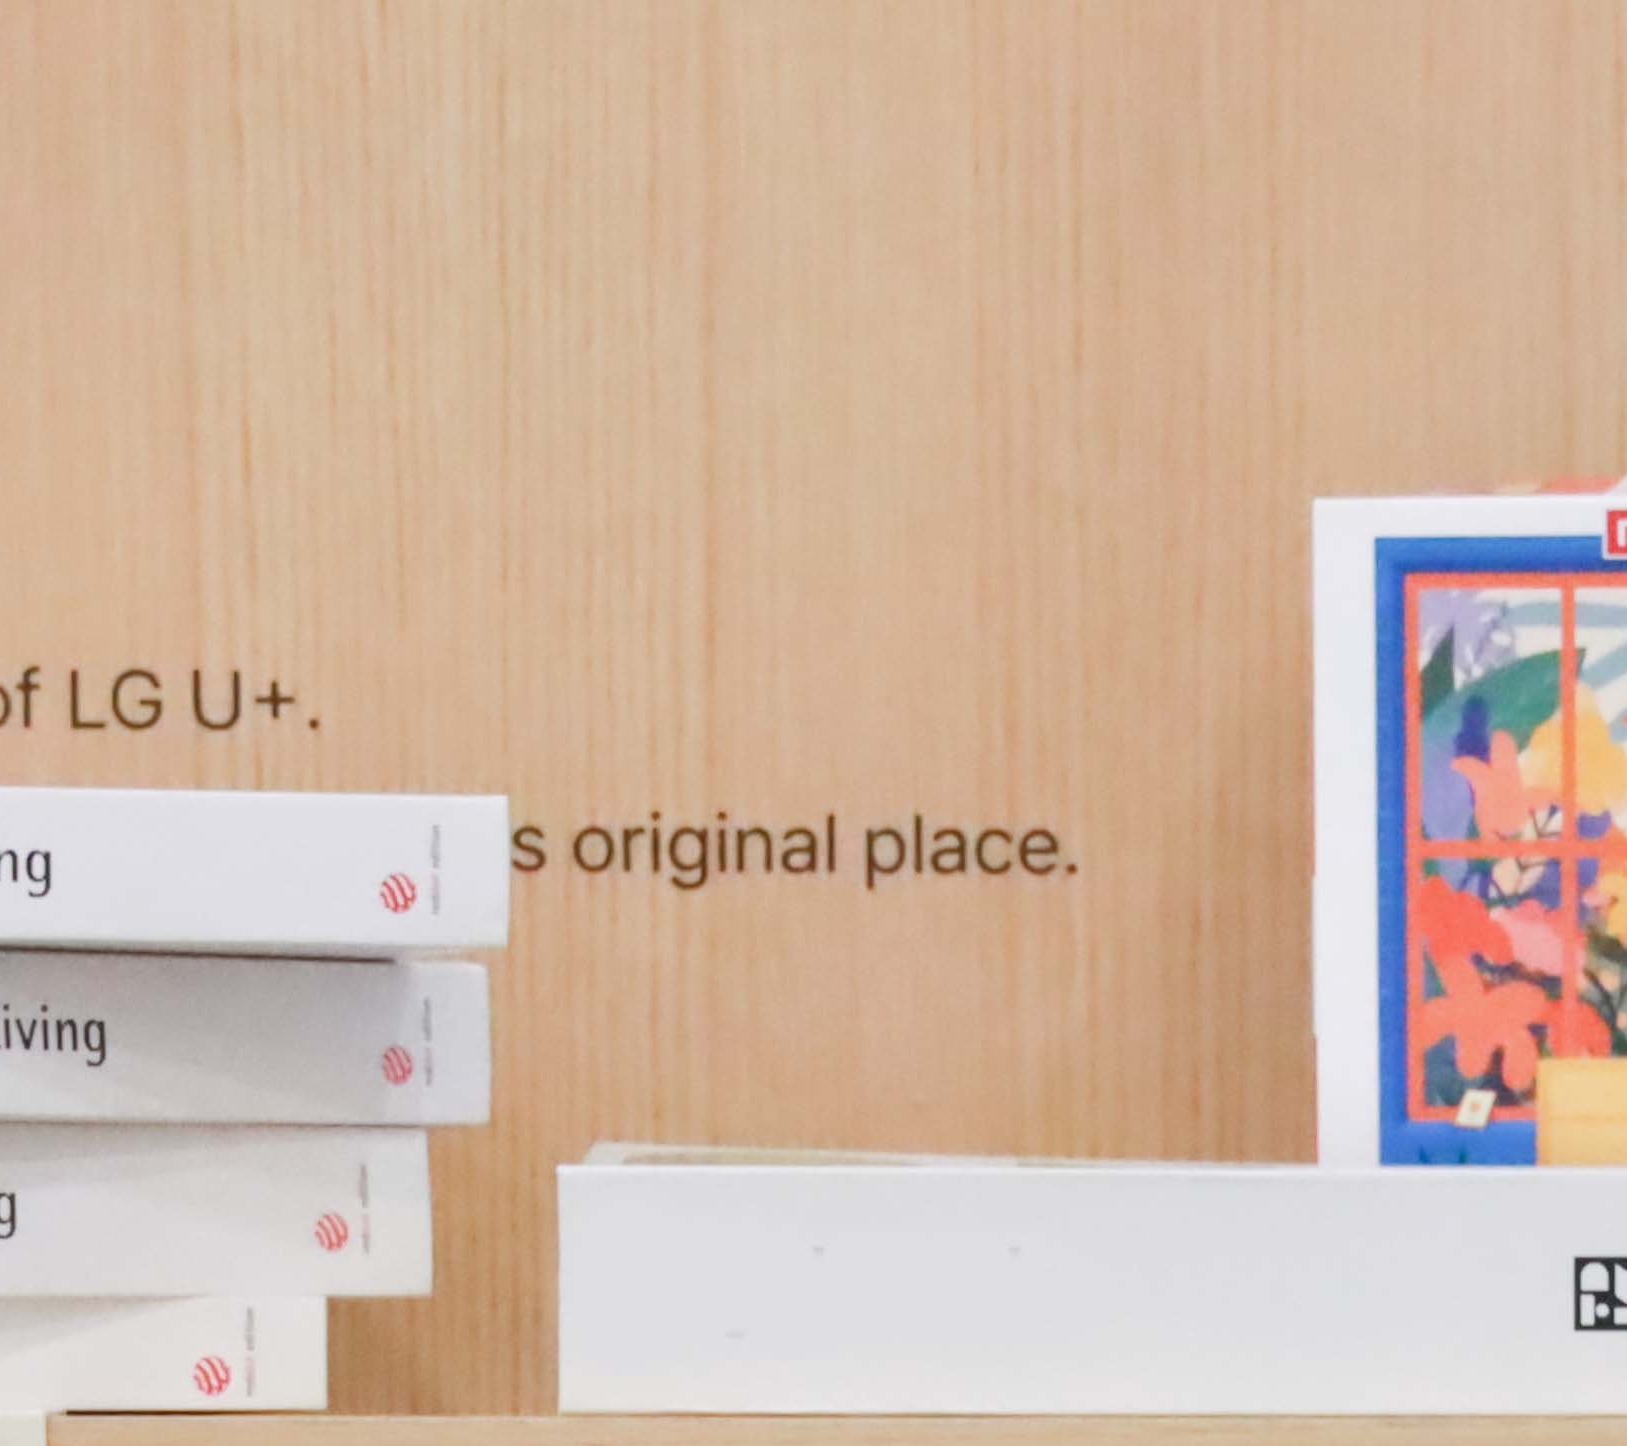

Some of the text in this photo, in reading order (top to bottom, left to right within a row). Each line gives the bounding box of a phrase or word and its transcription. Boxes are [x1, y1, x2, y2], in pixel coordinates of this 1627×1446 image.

[70, 669, 162, 730] LG
[193, 669, 319, 730] U+.
[573, 811, 1077, 890] original place.
